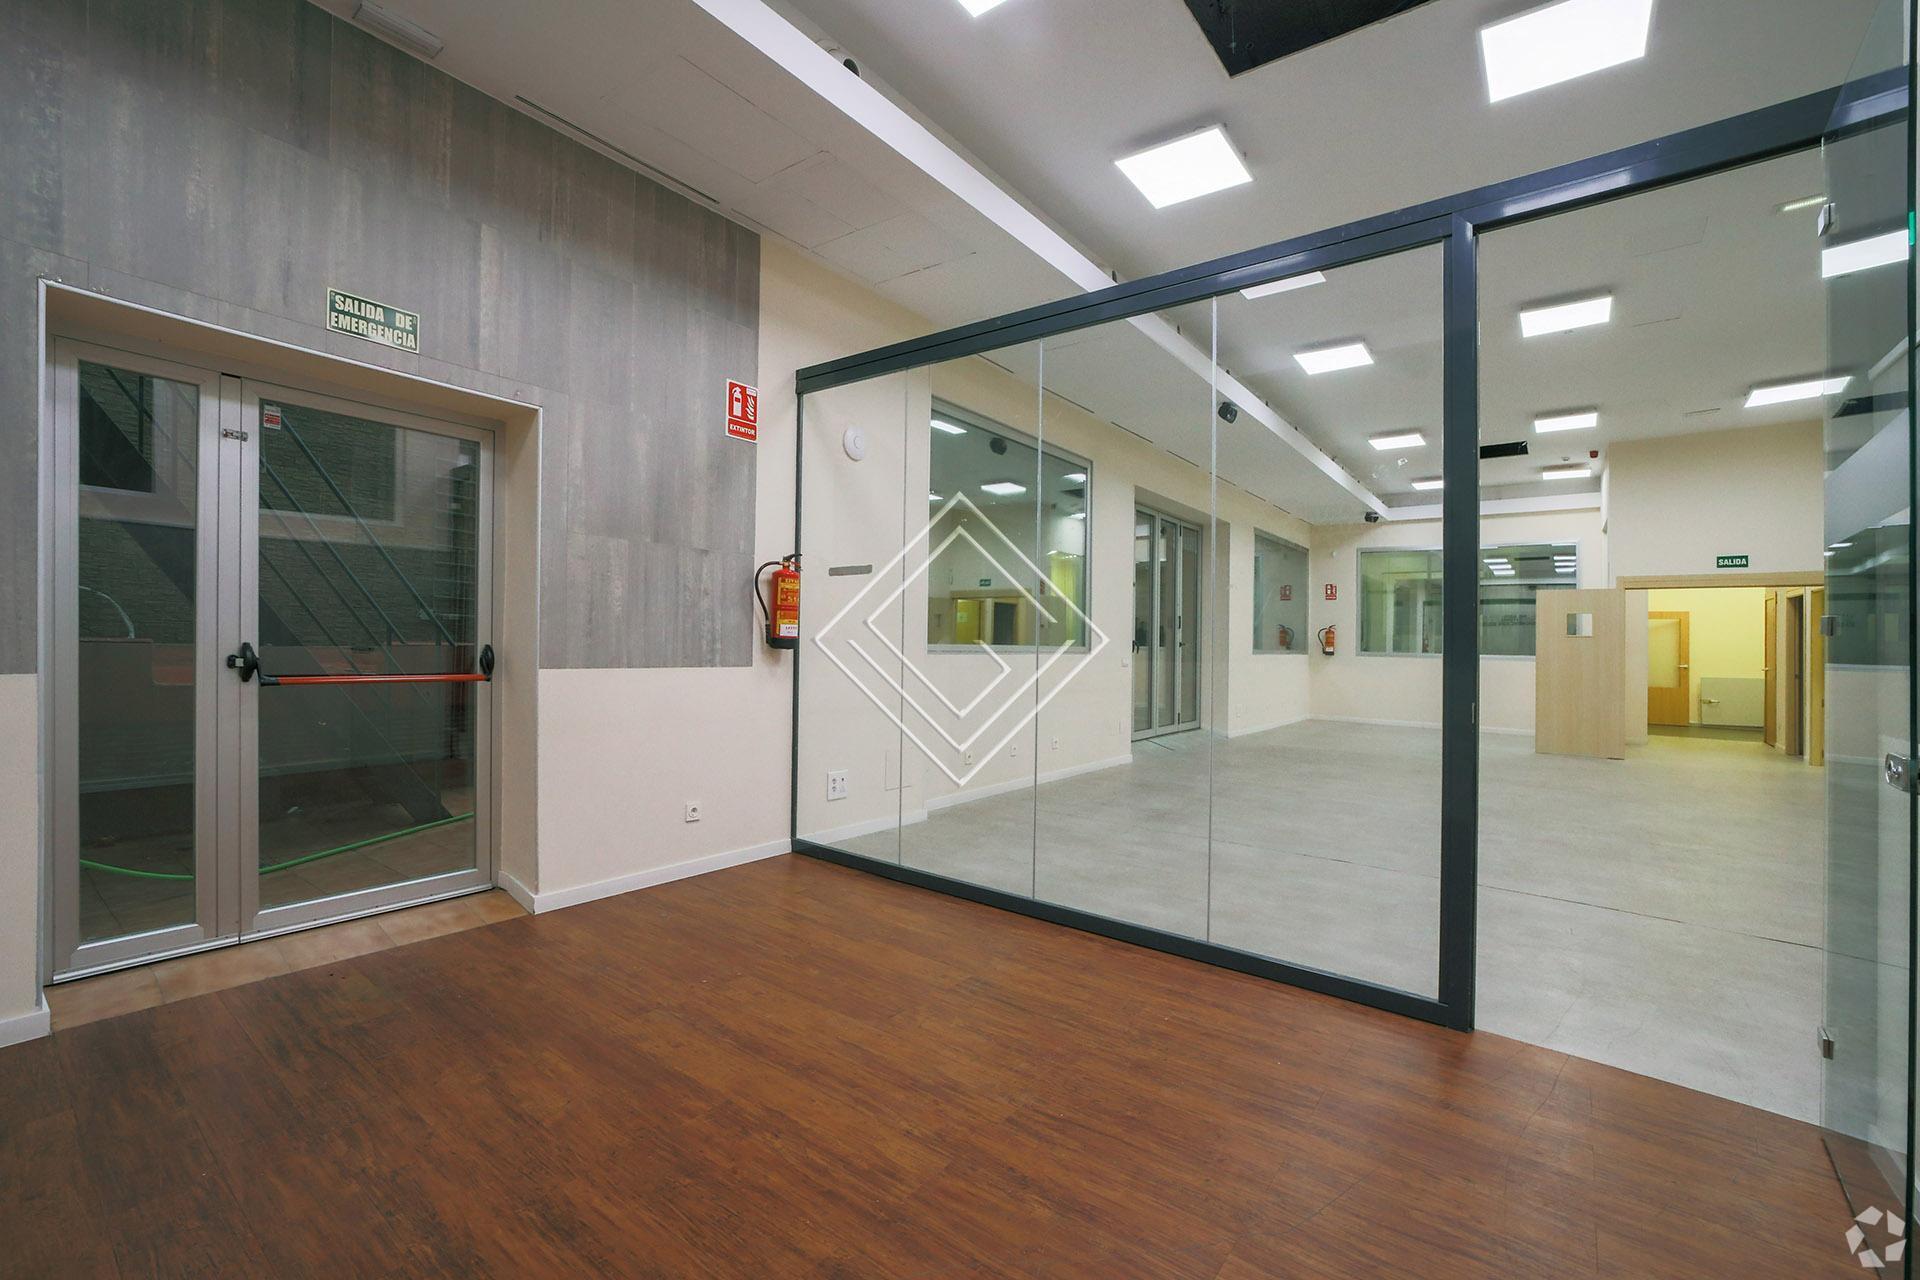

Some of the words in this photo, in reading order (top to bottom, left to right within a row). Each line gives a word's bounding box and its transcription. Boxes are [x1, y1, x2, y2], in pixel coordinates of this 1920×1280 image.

[334, 294, 385, 322] SALIDA
[395, 312, 413, 330] DE
[330, 311, 416, 348] EMERGENCIA
[730, 424, 755, 435] EXTINTOR
[1718, 558, 1747, 566] SALIDA
